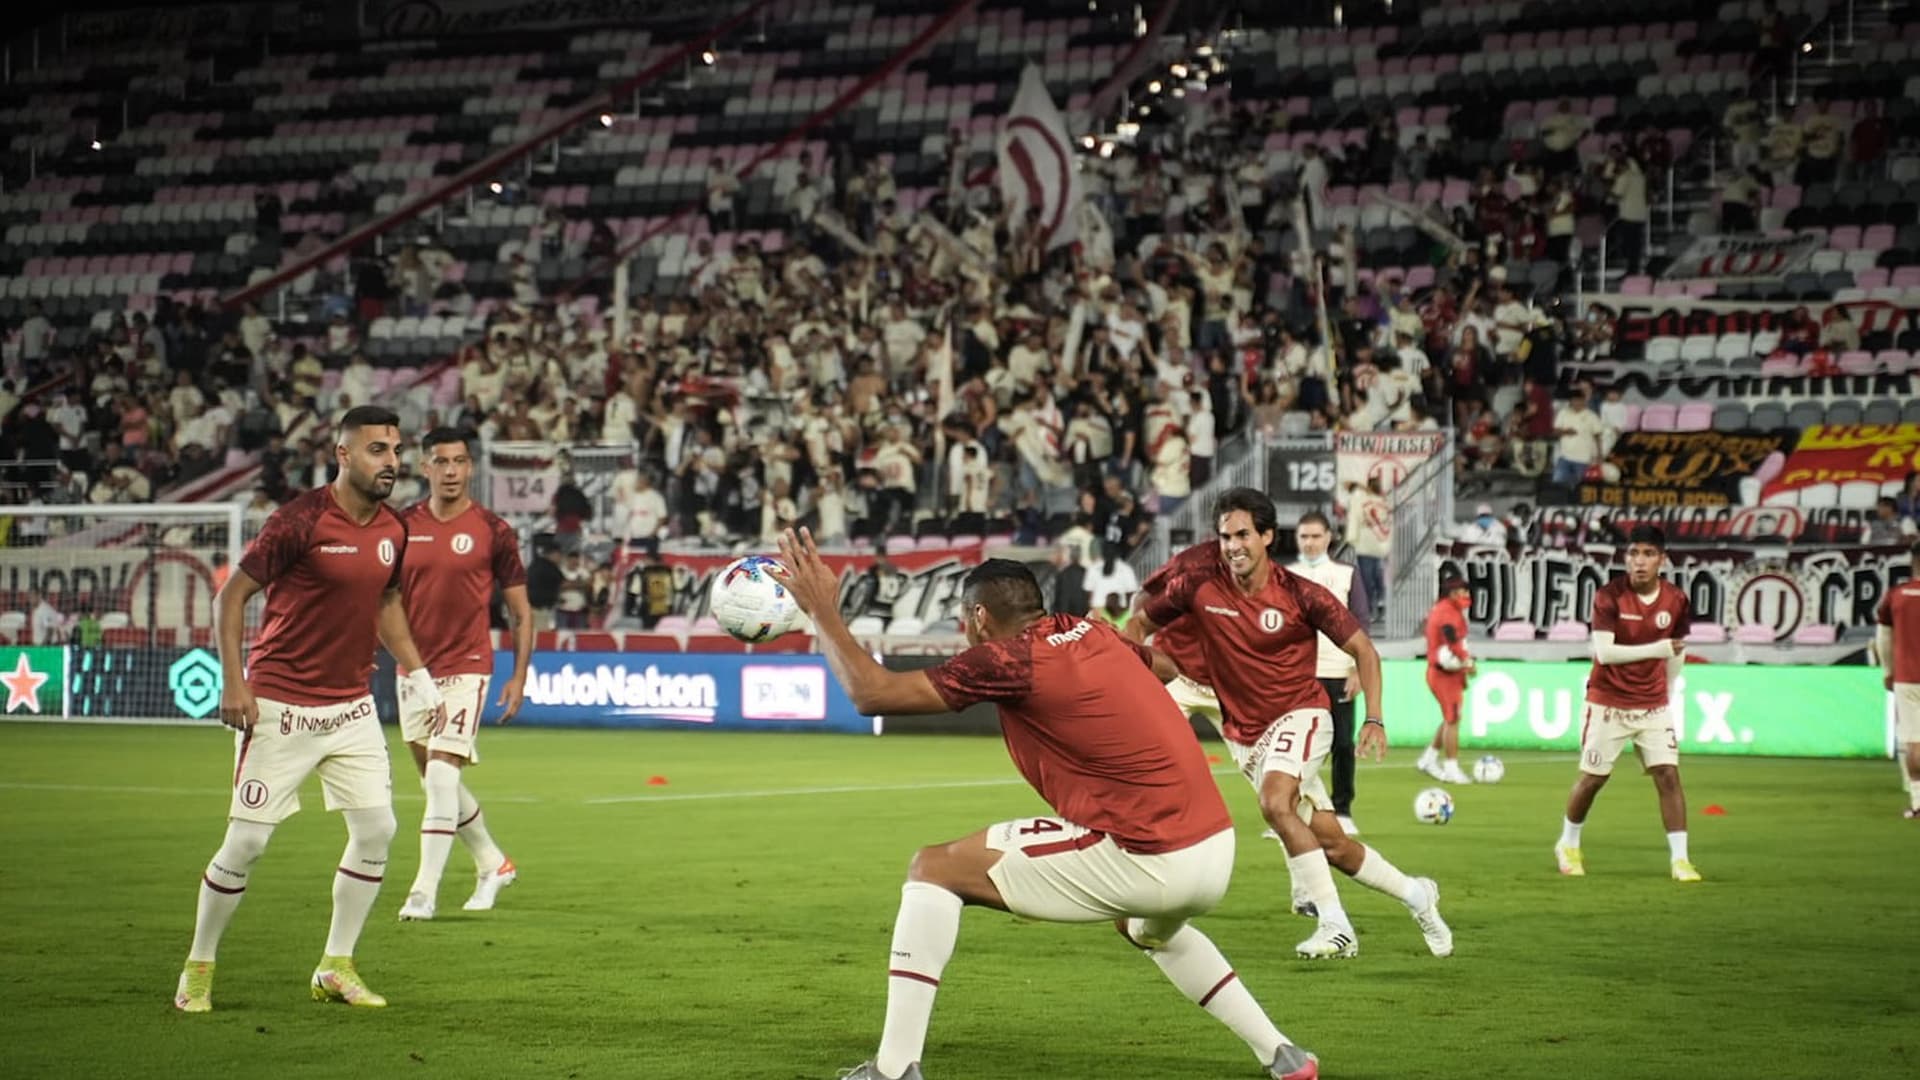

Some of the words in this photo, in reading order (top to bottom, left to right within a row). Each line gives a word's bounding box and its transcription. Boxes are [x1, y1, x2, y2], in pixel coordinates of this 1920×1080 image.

[1287, 462, 1336, 491] 125
[507, 477, 545, 498] 124
[320, 545, 358, 554] marathon
[523, 664, 718, 707] AutoNation
[245, 784, 262, 805] U
